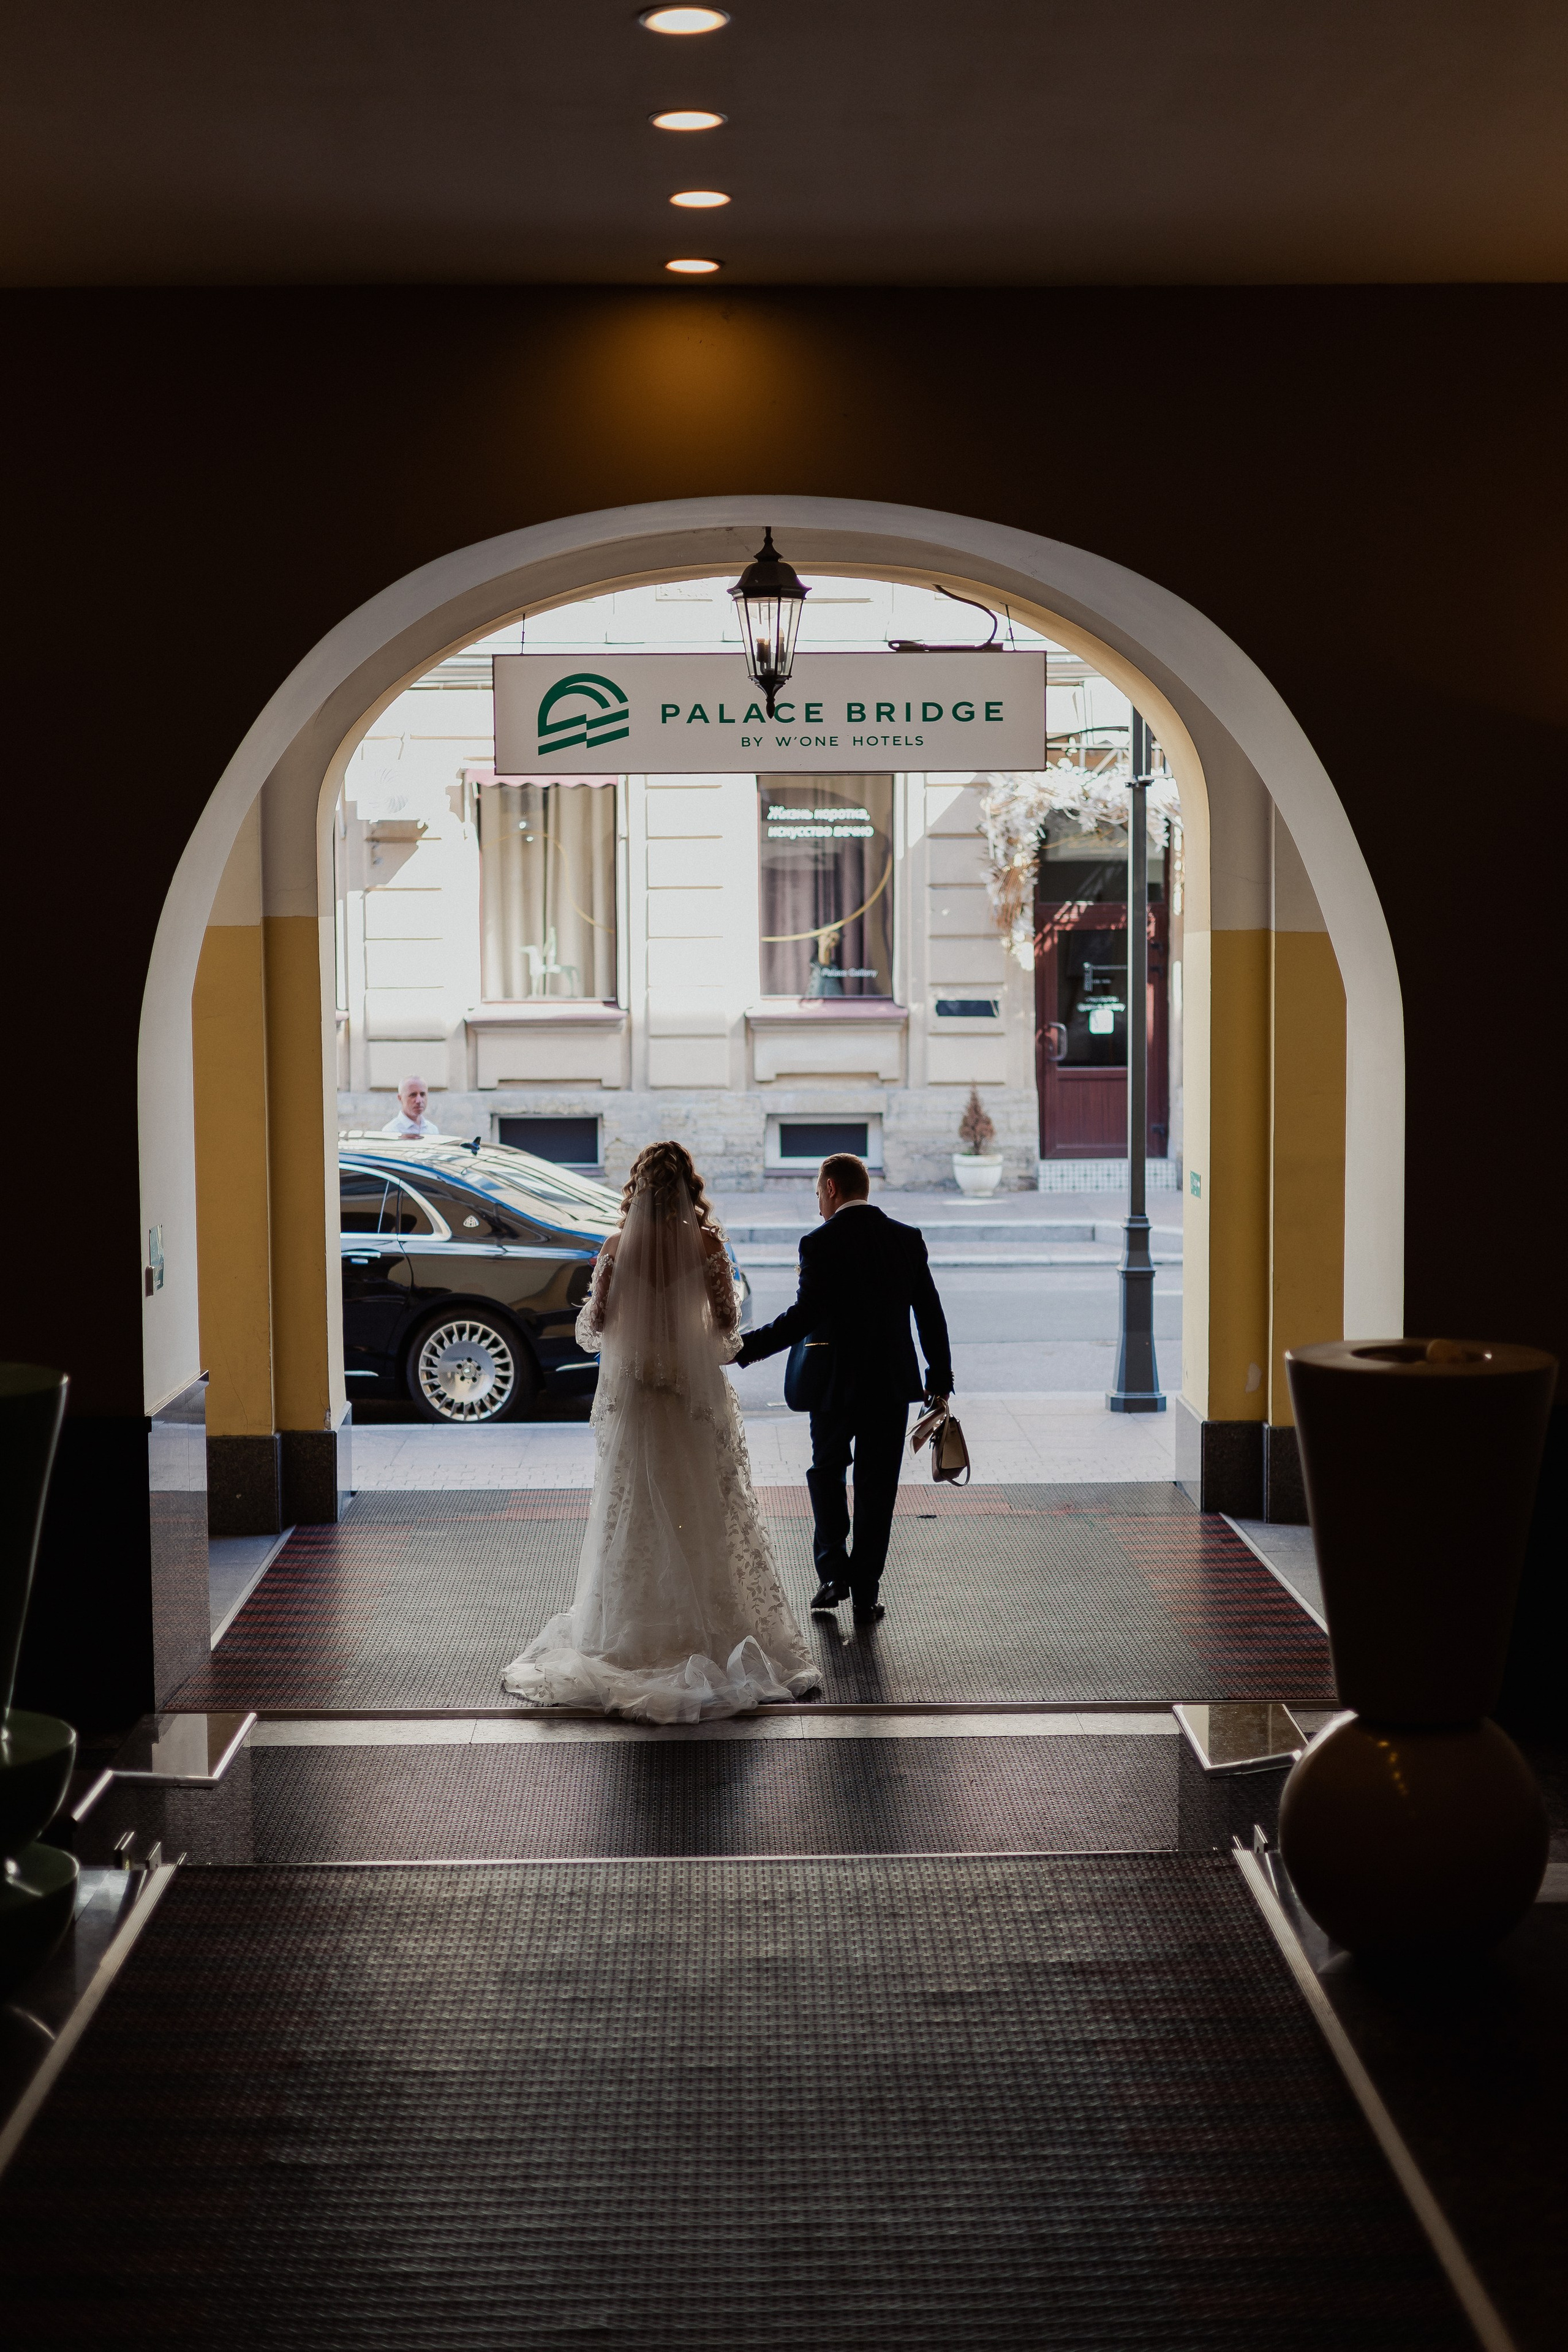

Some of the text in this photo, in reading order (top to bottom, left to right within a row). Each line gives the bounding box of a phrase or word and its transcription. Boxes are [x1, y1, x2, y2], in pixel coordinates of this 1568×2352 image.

[661, 701, 1003, 724] PALACE BRIDGE
[741, 736, 763, 747] BY
[853, 735, 924, 746] HOTELS
